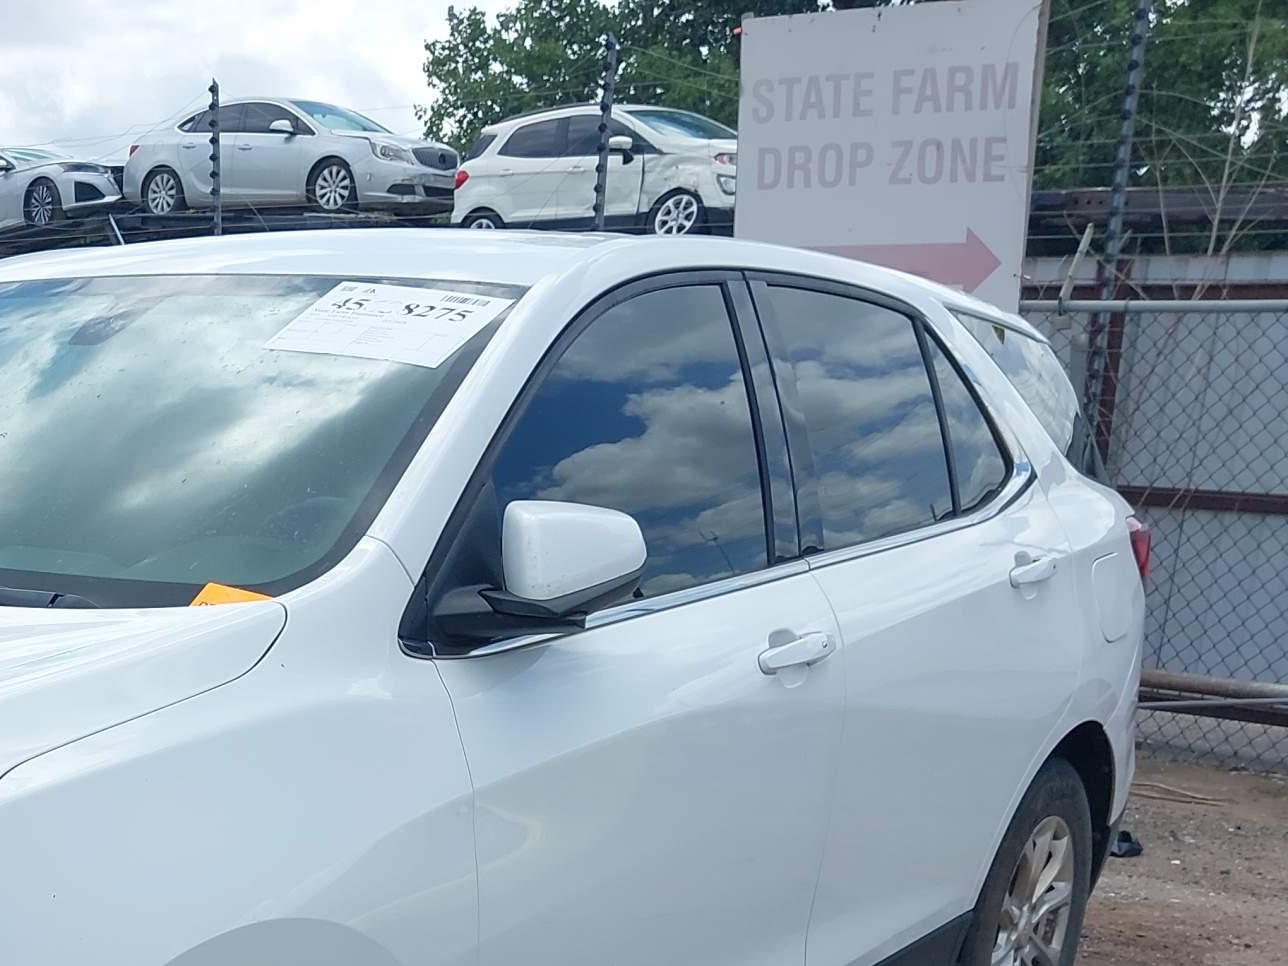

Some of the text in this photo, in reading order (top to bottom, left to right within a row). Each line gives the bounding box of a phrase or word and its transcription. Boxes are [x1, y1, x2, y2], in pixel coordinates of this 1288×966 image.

[752, 64, 1018, 124] STATE FARM
[757, 137, 1008, 190] DROP ZONE
